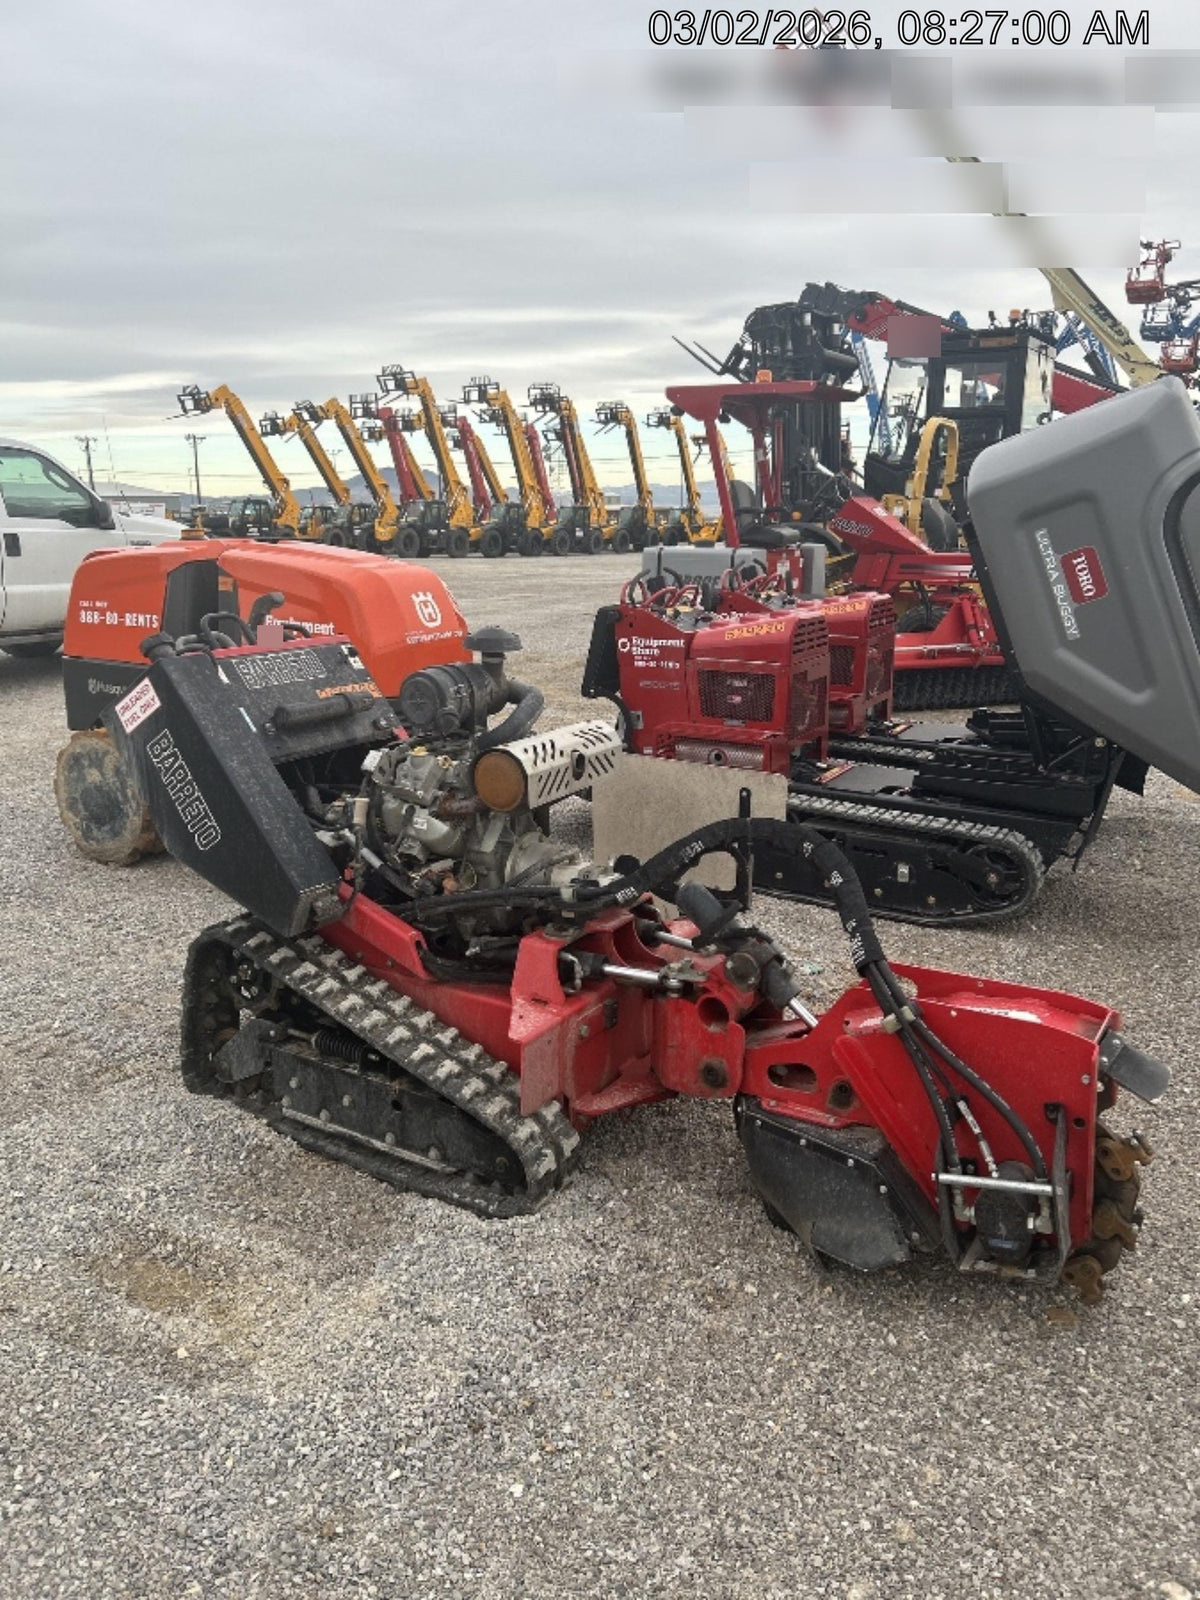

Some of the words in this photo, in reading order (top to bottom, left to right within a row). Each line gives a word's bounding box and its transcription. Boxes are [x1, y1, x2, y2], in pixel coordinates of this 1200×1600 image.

[1034, 528, 1060, 582] ULTRA
[1052, 584, 1081, 635] BUGGY
[1072, 552, 1096, 597] TORO
[632, 636, 685, 648] Equipment
[632, 646, 660, 656] Share
[231, 648, 328, 691] BARRETO
[146, 728, 221, 851] BARRETO
